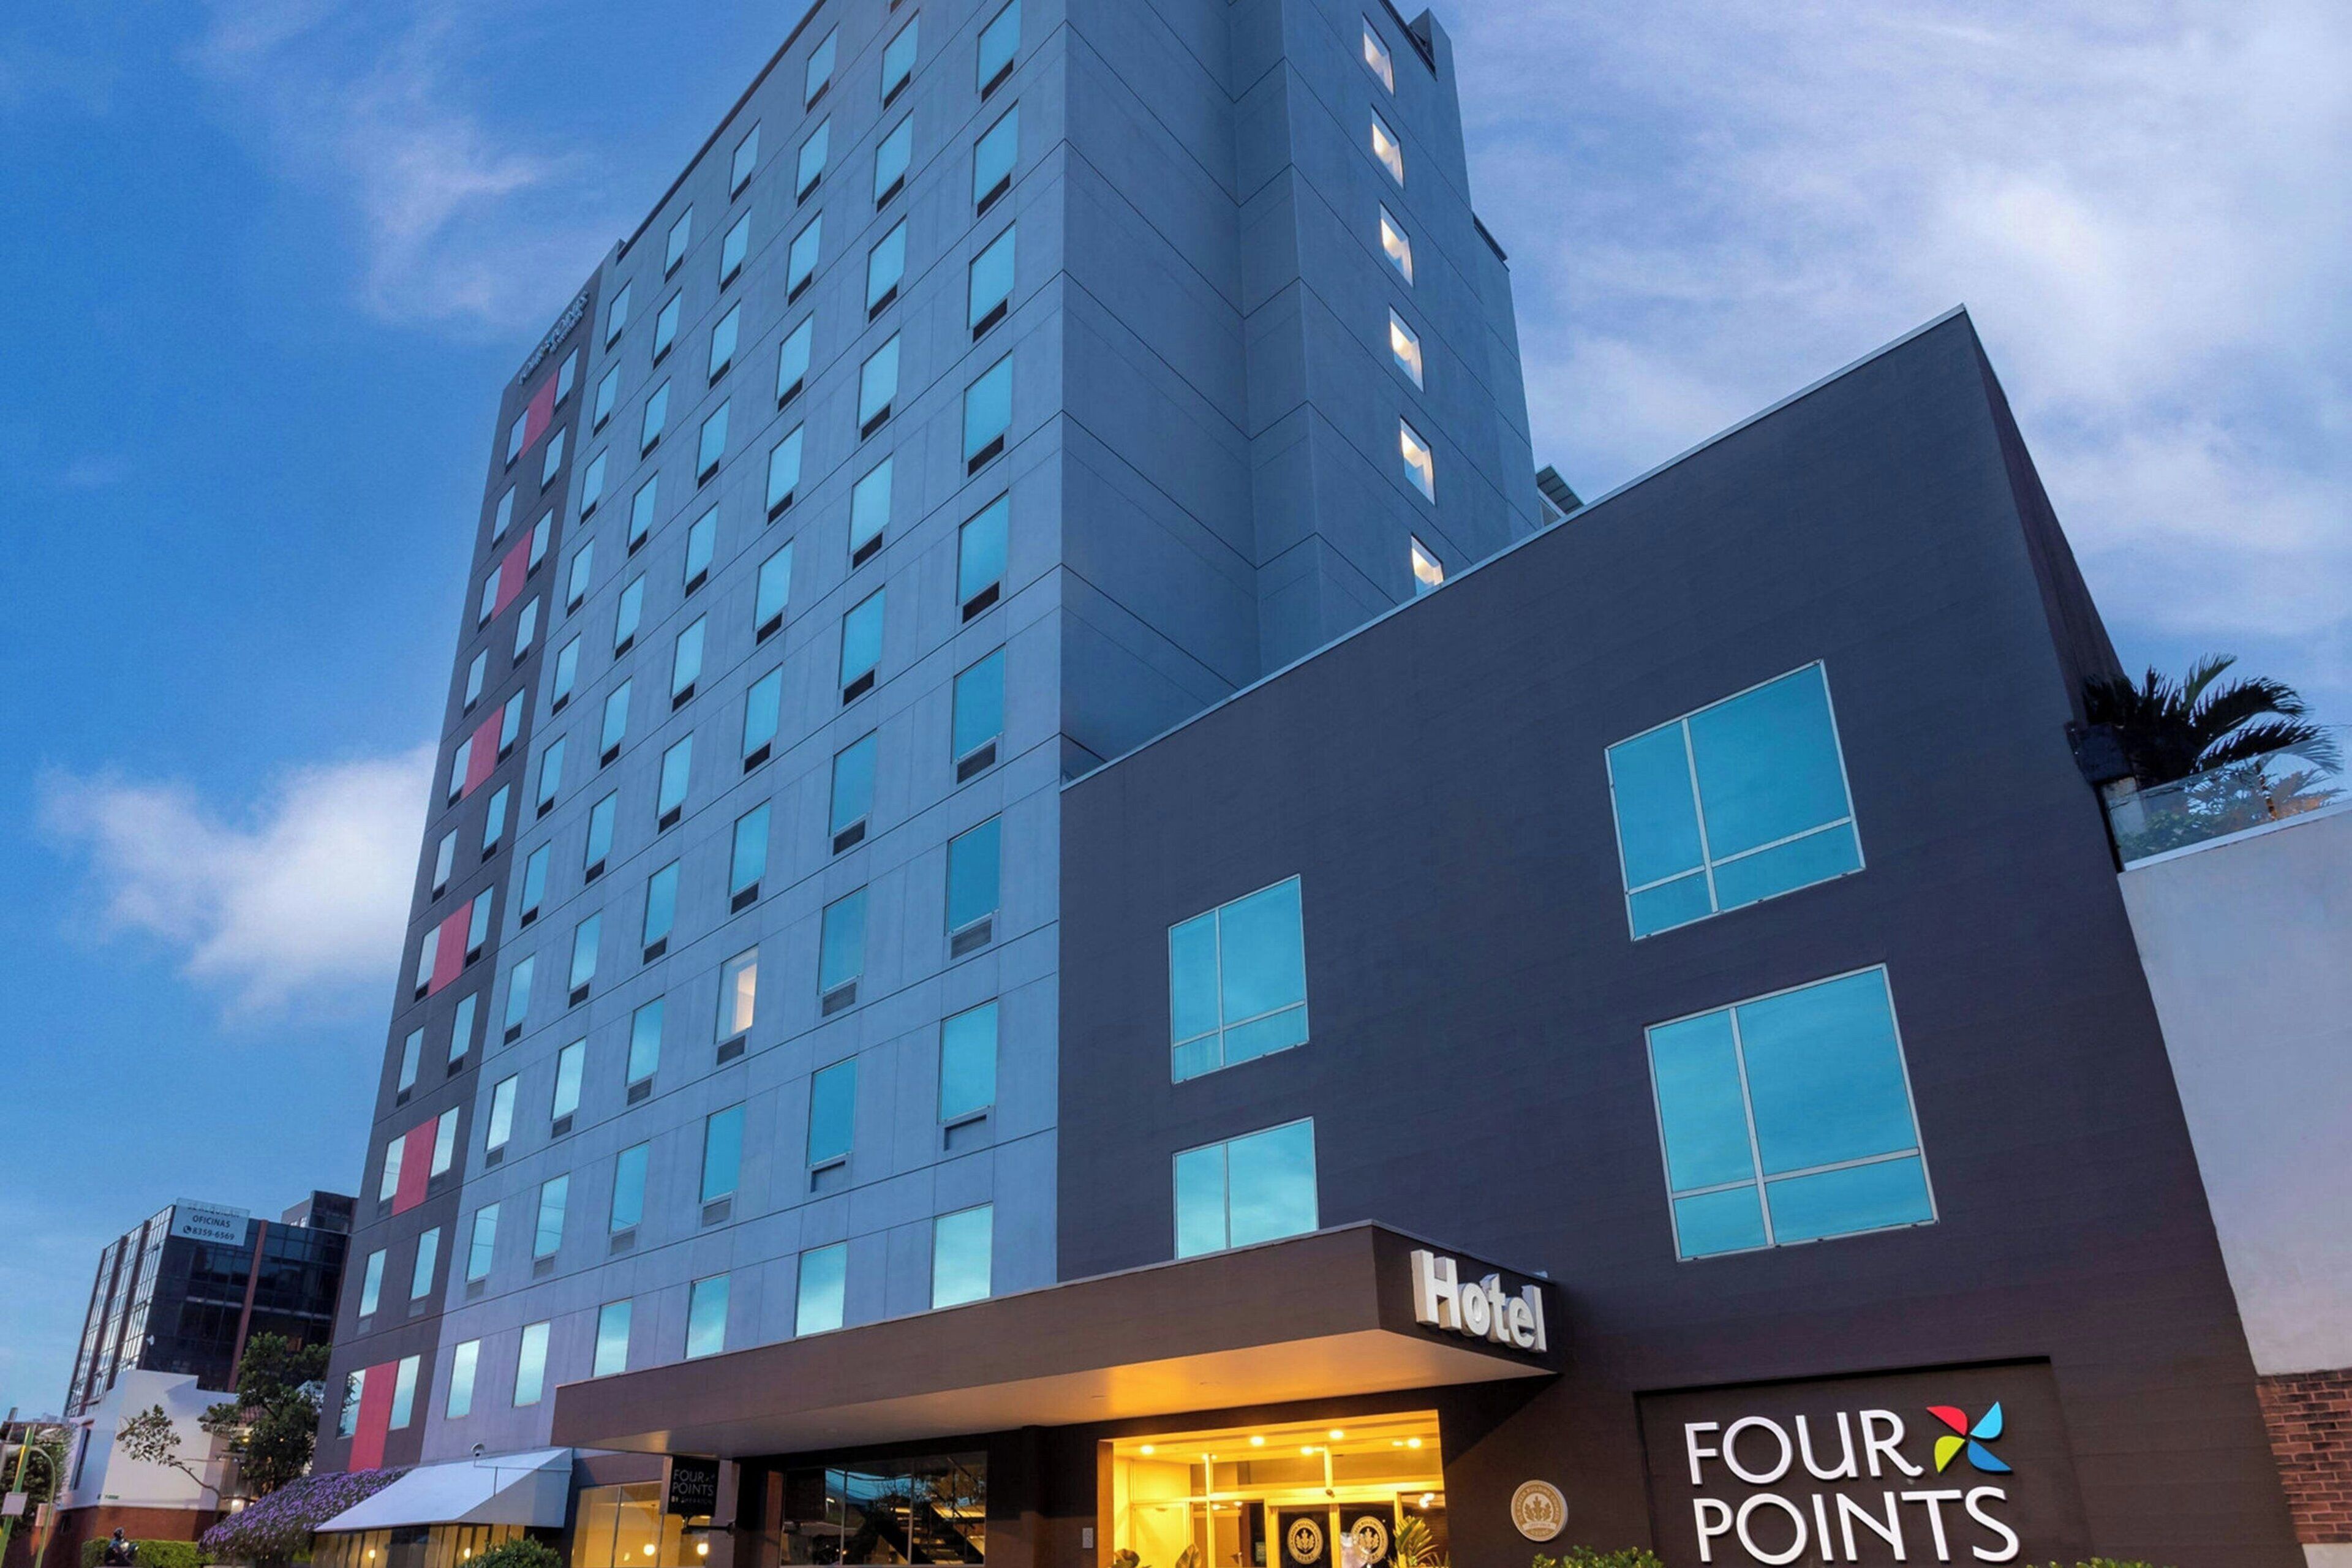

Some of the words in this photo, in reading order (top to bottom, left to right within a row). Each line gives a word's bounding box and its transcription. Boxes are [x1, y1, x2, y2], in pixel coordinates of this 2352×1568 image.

[193, 1215, 230, 1227] OFICINAS
[192, 1227, 235, 1240] 8359-6569
[1411, 1250, 1547, 1352] Hotel
[1684, 1409, 1925, 1485] FOUR
[674, 1469, 704, 1483] FOUR
[673, 1482, 714, 1496] POINTS
[1693, 1486, 2020, 1566] POINTS
